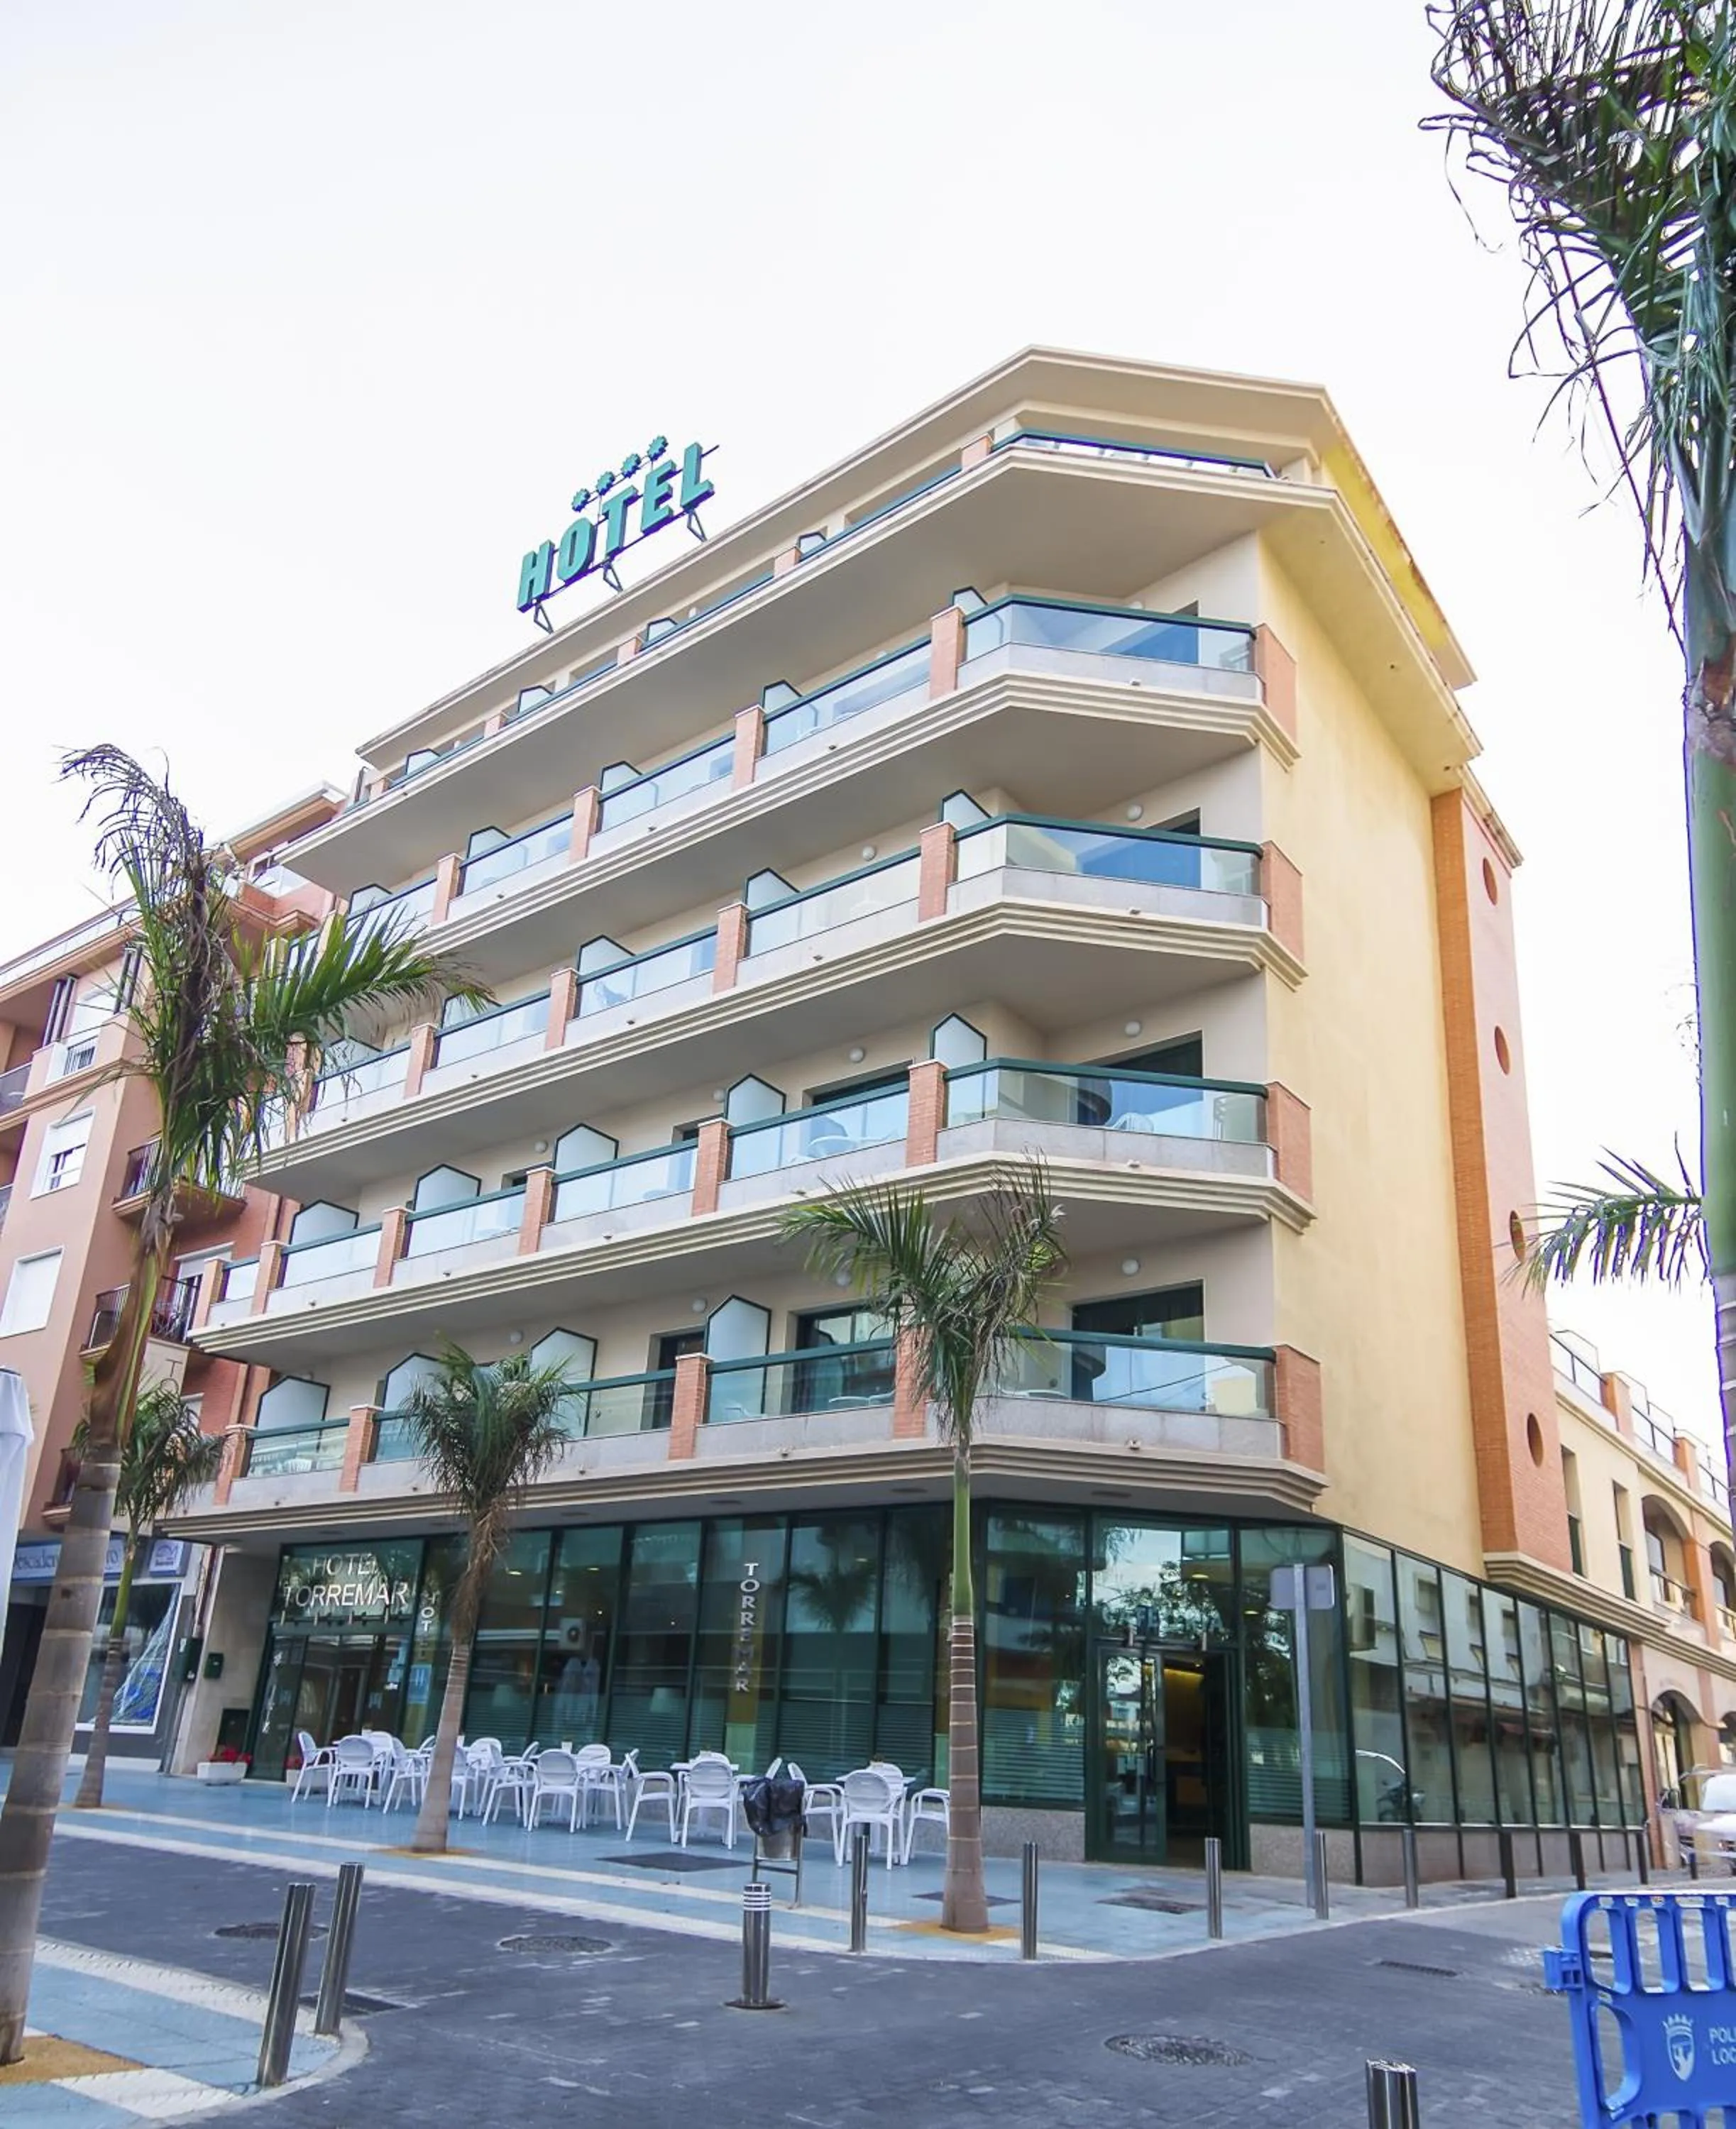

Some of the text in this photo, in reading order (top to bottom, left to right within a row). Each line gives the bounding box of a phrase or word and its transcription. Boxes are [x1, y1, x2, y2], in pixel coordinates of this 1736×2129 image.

[517, 441, 715, 613] HOTEL
[284, 1581, 409, 1607] TORREMAR
[312, 1552, 380, 1576] HOTEL
[732, 1563, 760, 1692] TORREMAR
